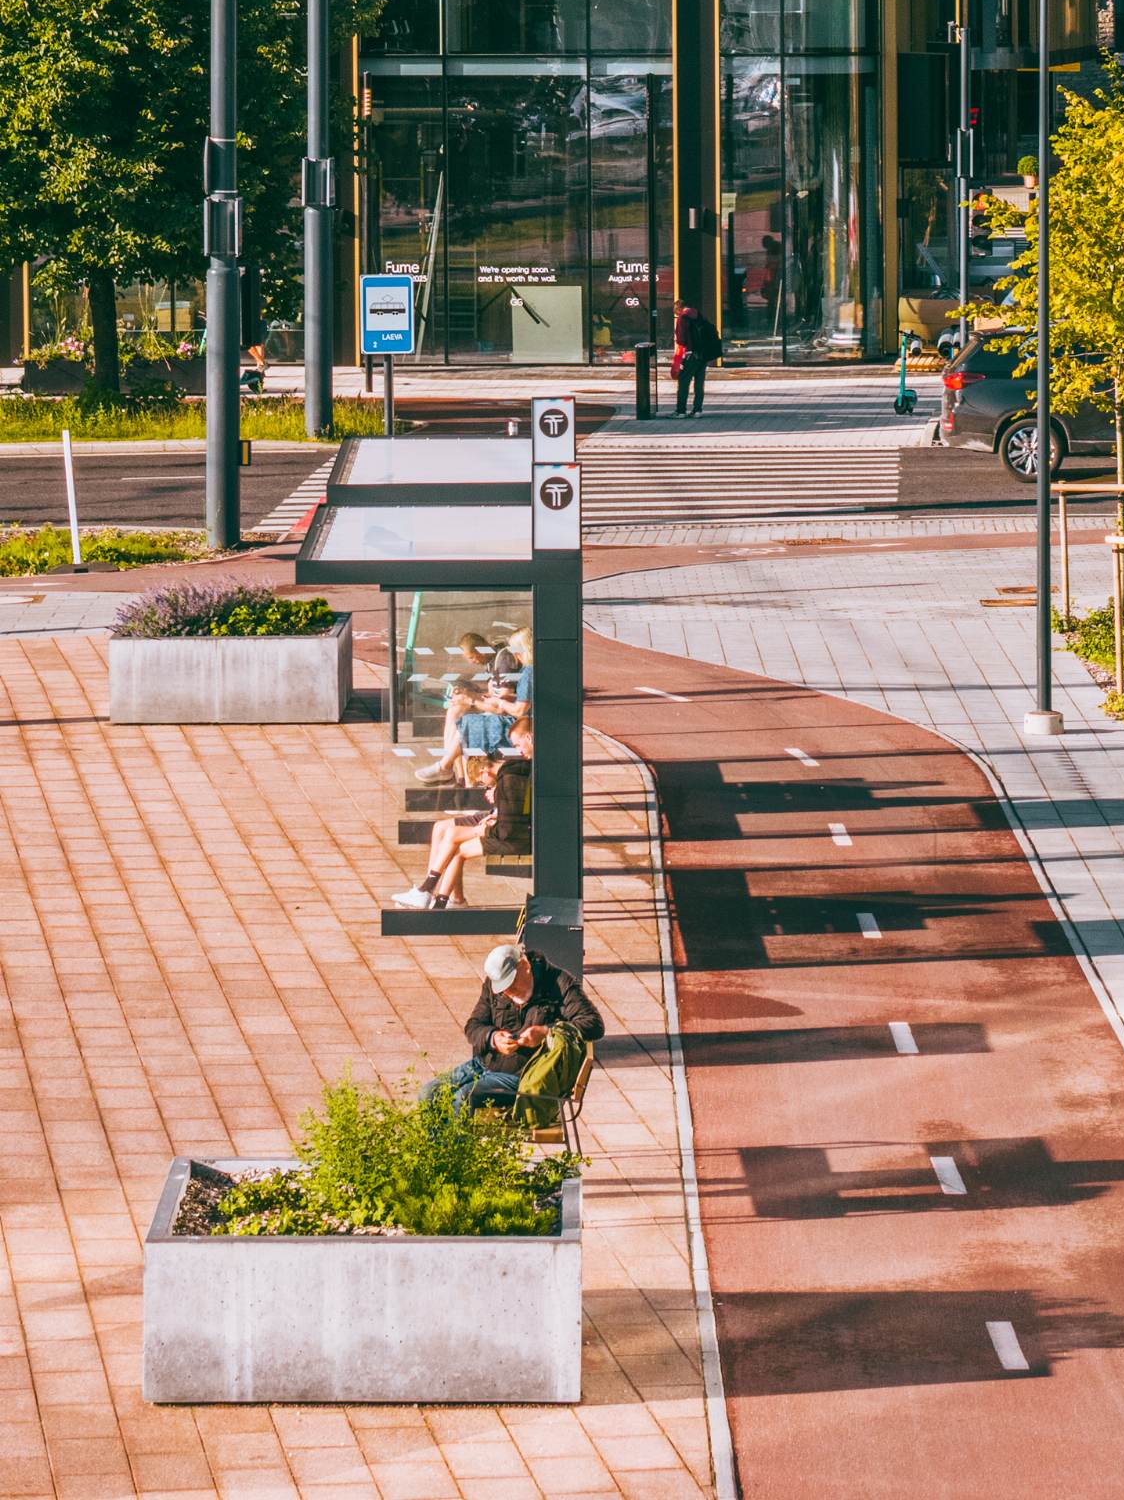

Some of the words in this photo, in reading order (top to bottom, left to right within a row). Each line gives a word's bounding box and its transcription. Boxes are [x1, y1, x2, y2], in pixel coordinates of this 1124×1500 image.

[385, 260, 420, 273] Fume
[501, 266, 530, 275] opening
[608, 274, 633, 284] August
[381, 333, 403, 341] LAEVA
